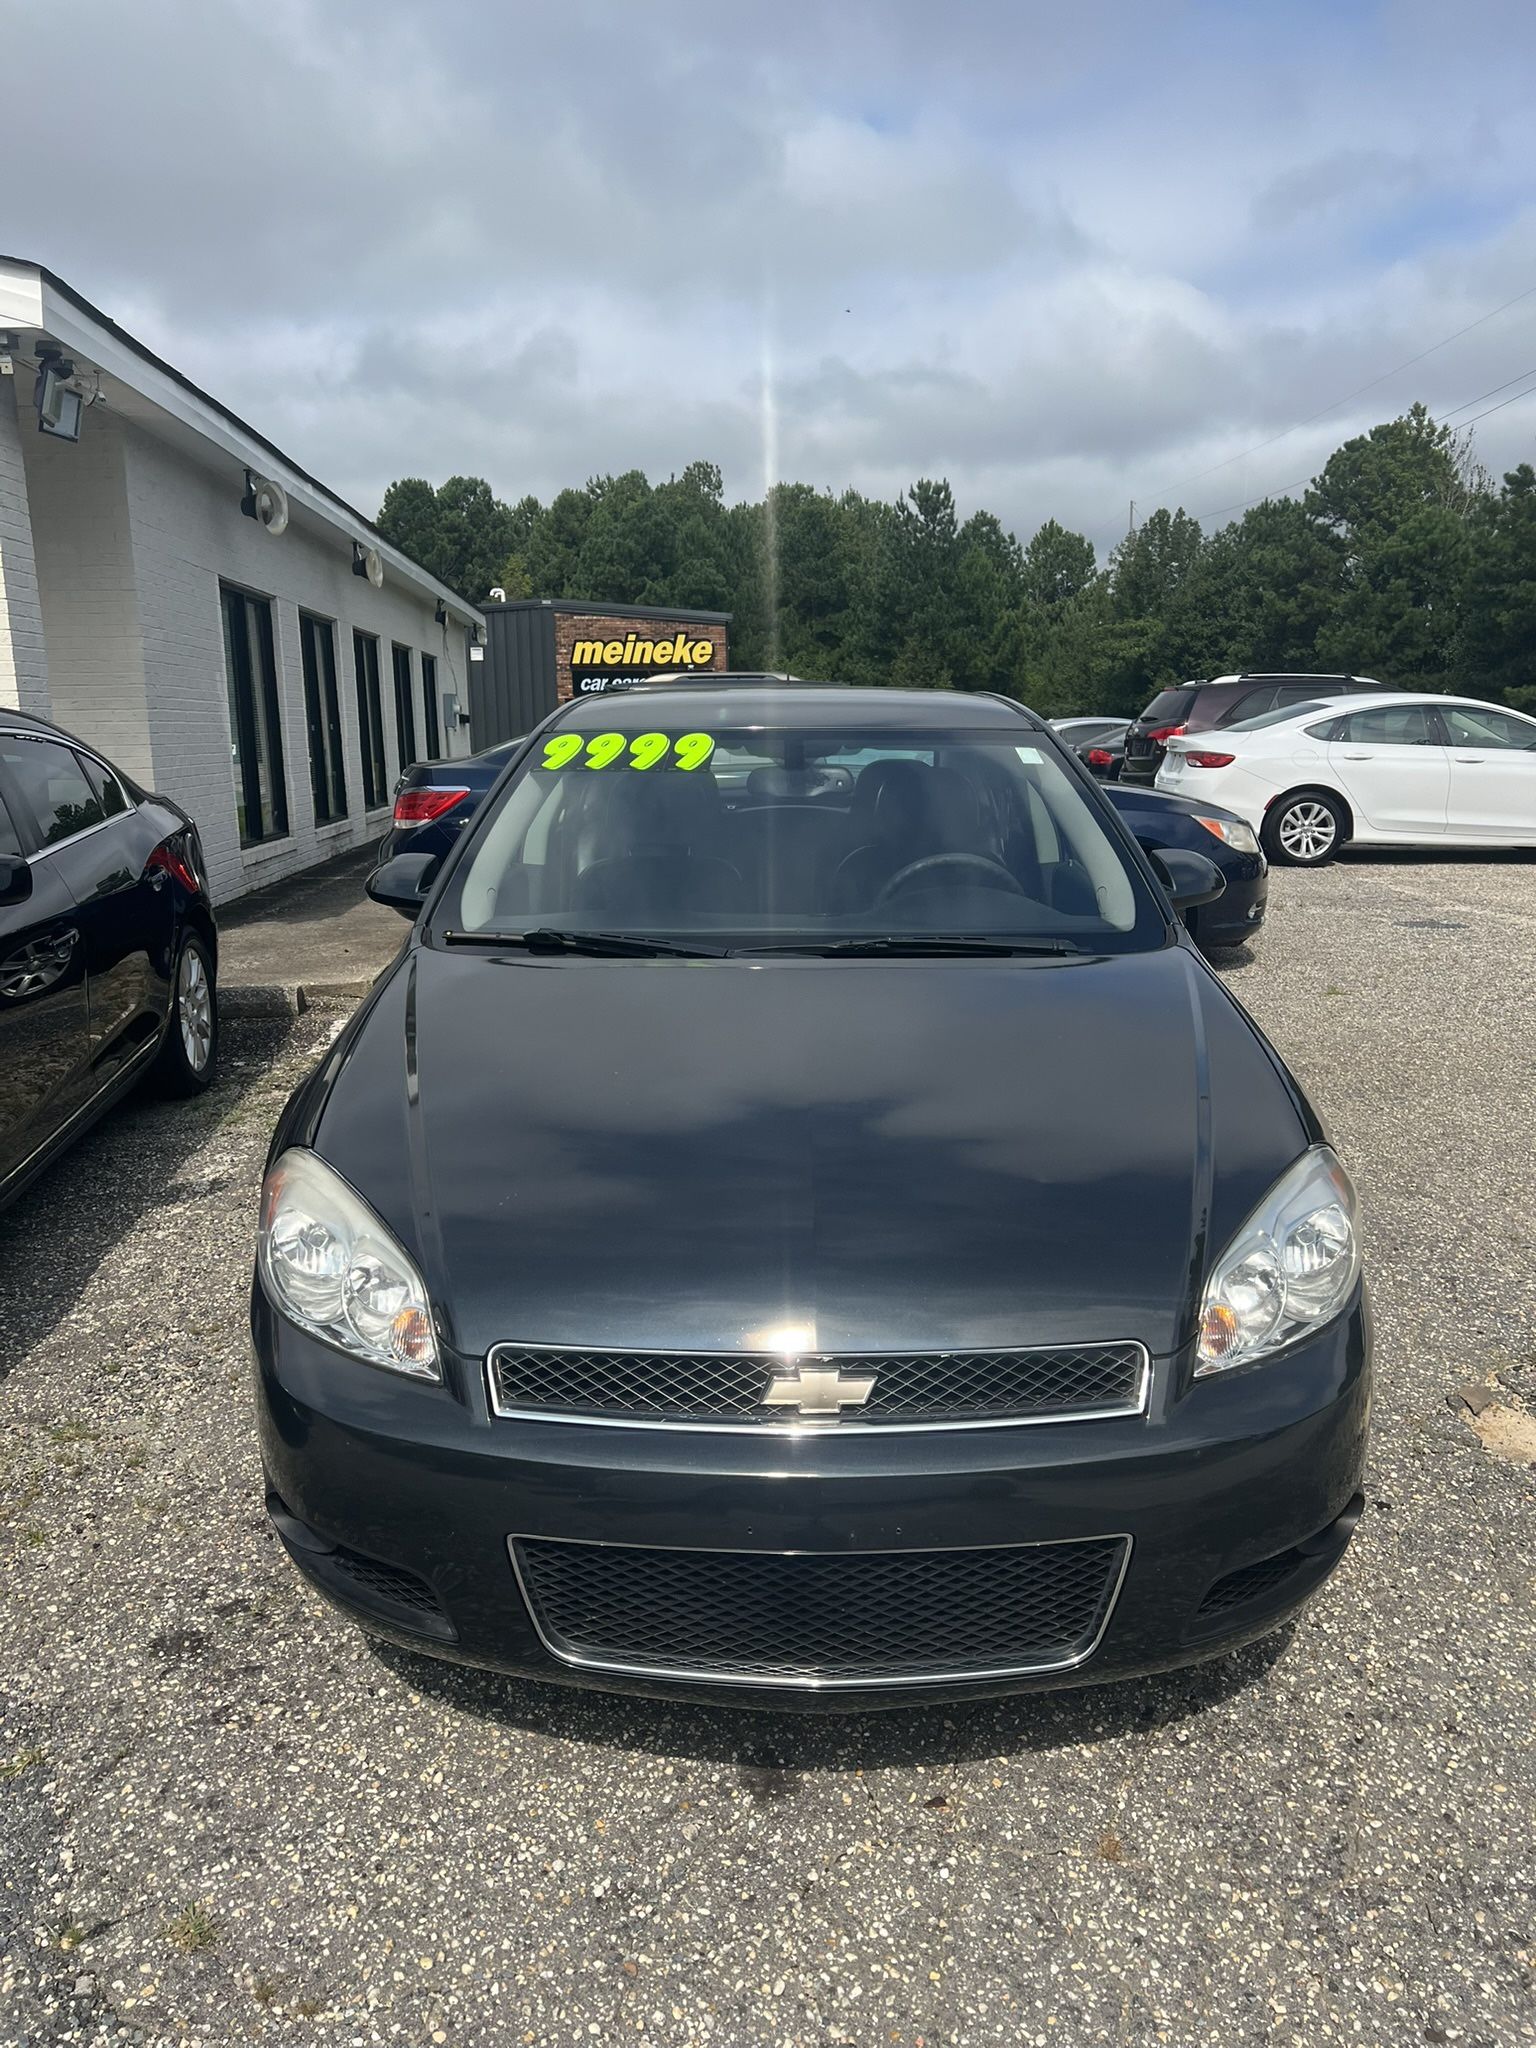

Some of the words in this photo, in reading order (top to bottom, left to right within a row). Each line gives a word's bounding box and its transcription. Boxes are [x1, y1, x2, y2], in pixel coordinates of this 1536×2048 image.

[571, 633, 713, 665] meineke
[580, 677, 609, 691] car
[541, 732, 716, 771] 9999
